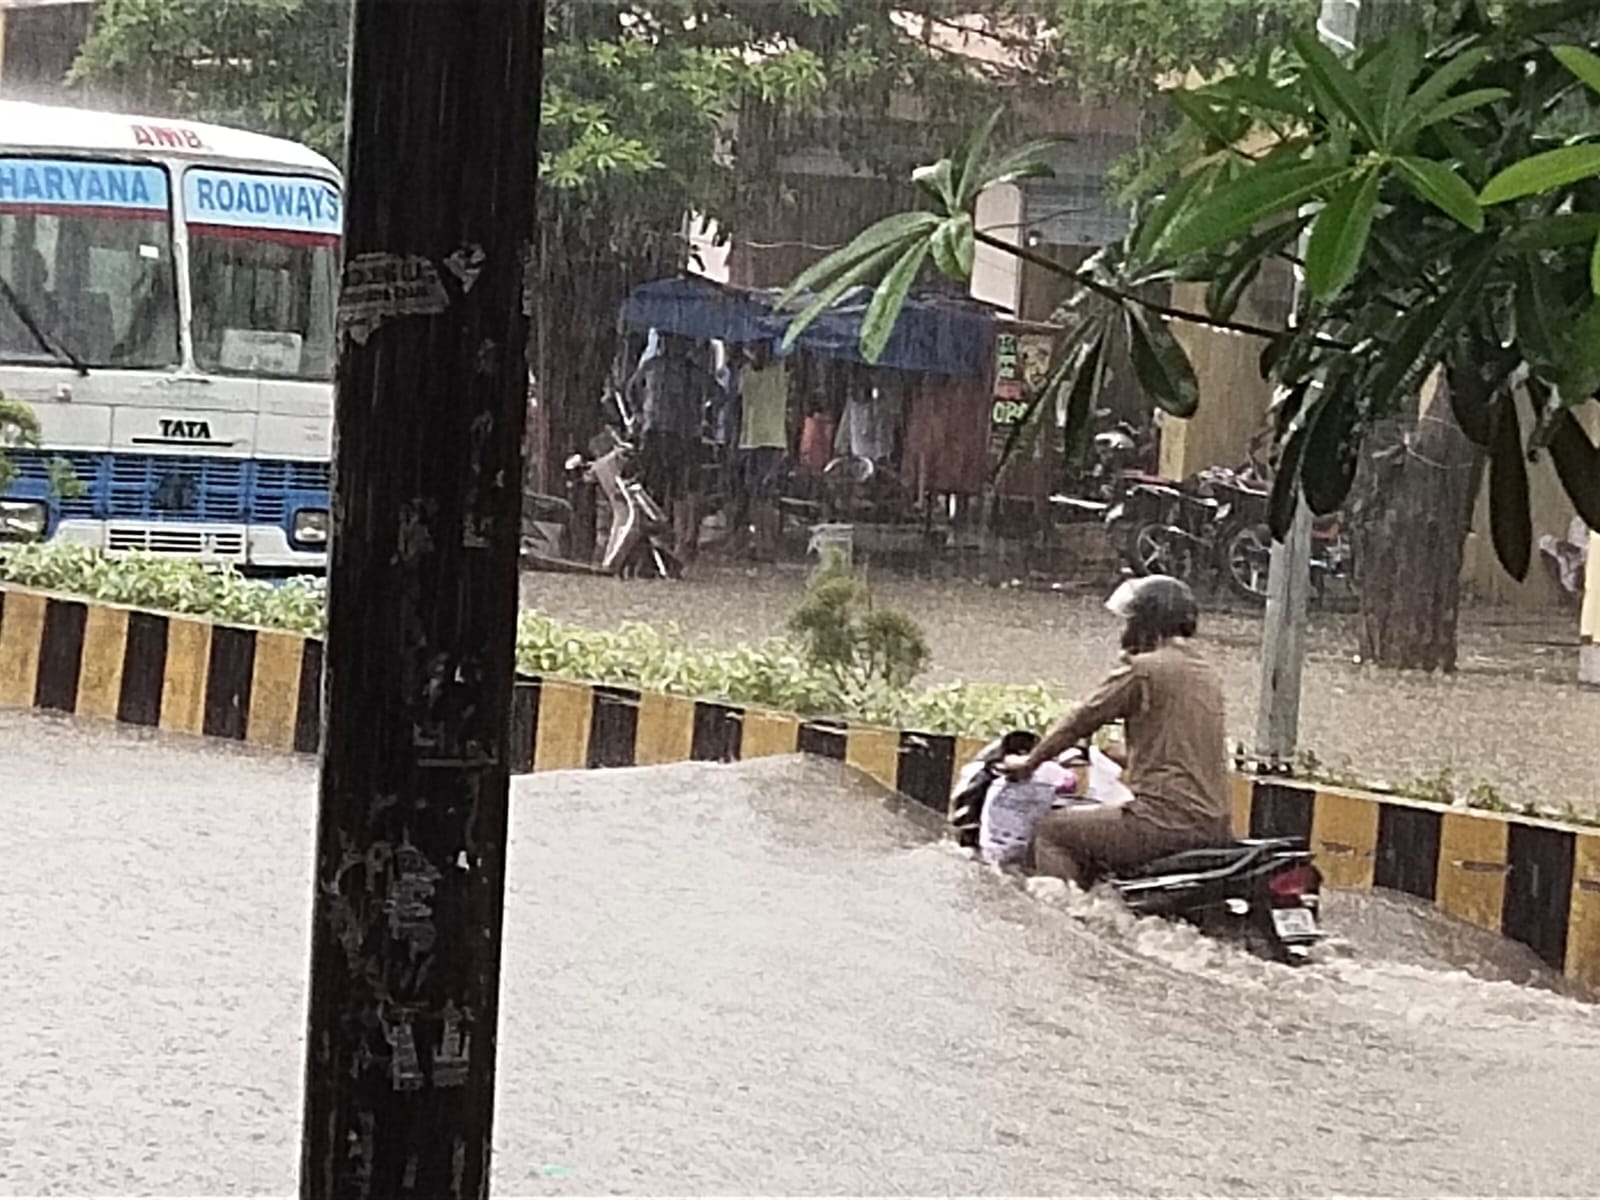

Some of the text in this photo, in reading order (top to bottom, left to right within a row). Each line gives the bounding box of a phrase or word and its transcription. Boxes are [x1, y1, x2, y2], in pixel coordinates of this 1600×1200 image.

[0, 166, 339, 223] HARYANA ROADWAYS
[159, 419, 211, 440] TATA
